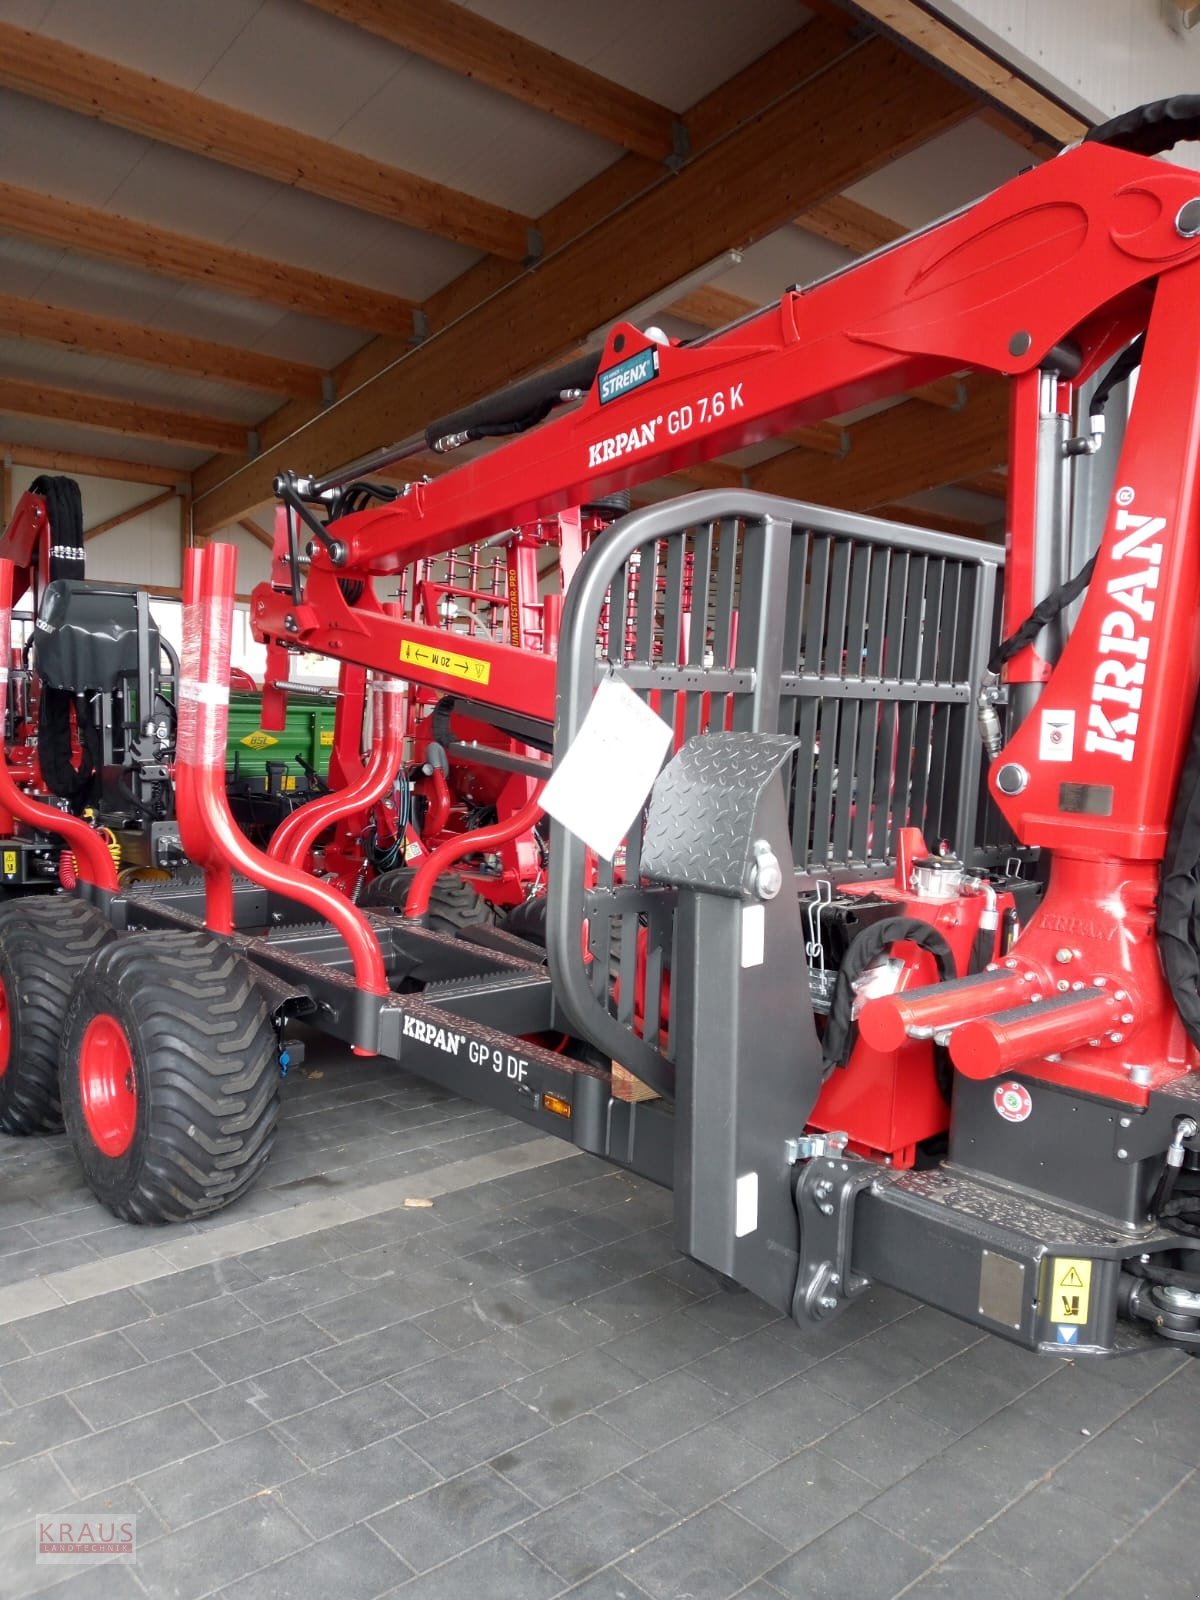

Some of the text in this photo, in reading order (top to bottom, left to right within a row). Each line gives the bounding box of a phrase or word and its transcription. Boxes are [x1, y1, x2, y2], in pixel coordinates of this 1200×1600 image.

[668, 405, 693, 435] GD
[698, 392, 725, 424] 7,6
[730, 383, 744, 410] K
[432, 653, 451, 668] 20 M
[469, 1041, 489, 1066] GP
[493, 1050, 503, 1072] 9
[507, 1055, 528, 1081] DF
